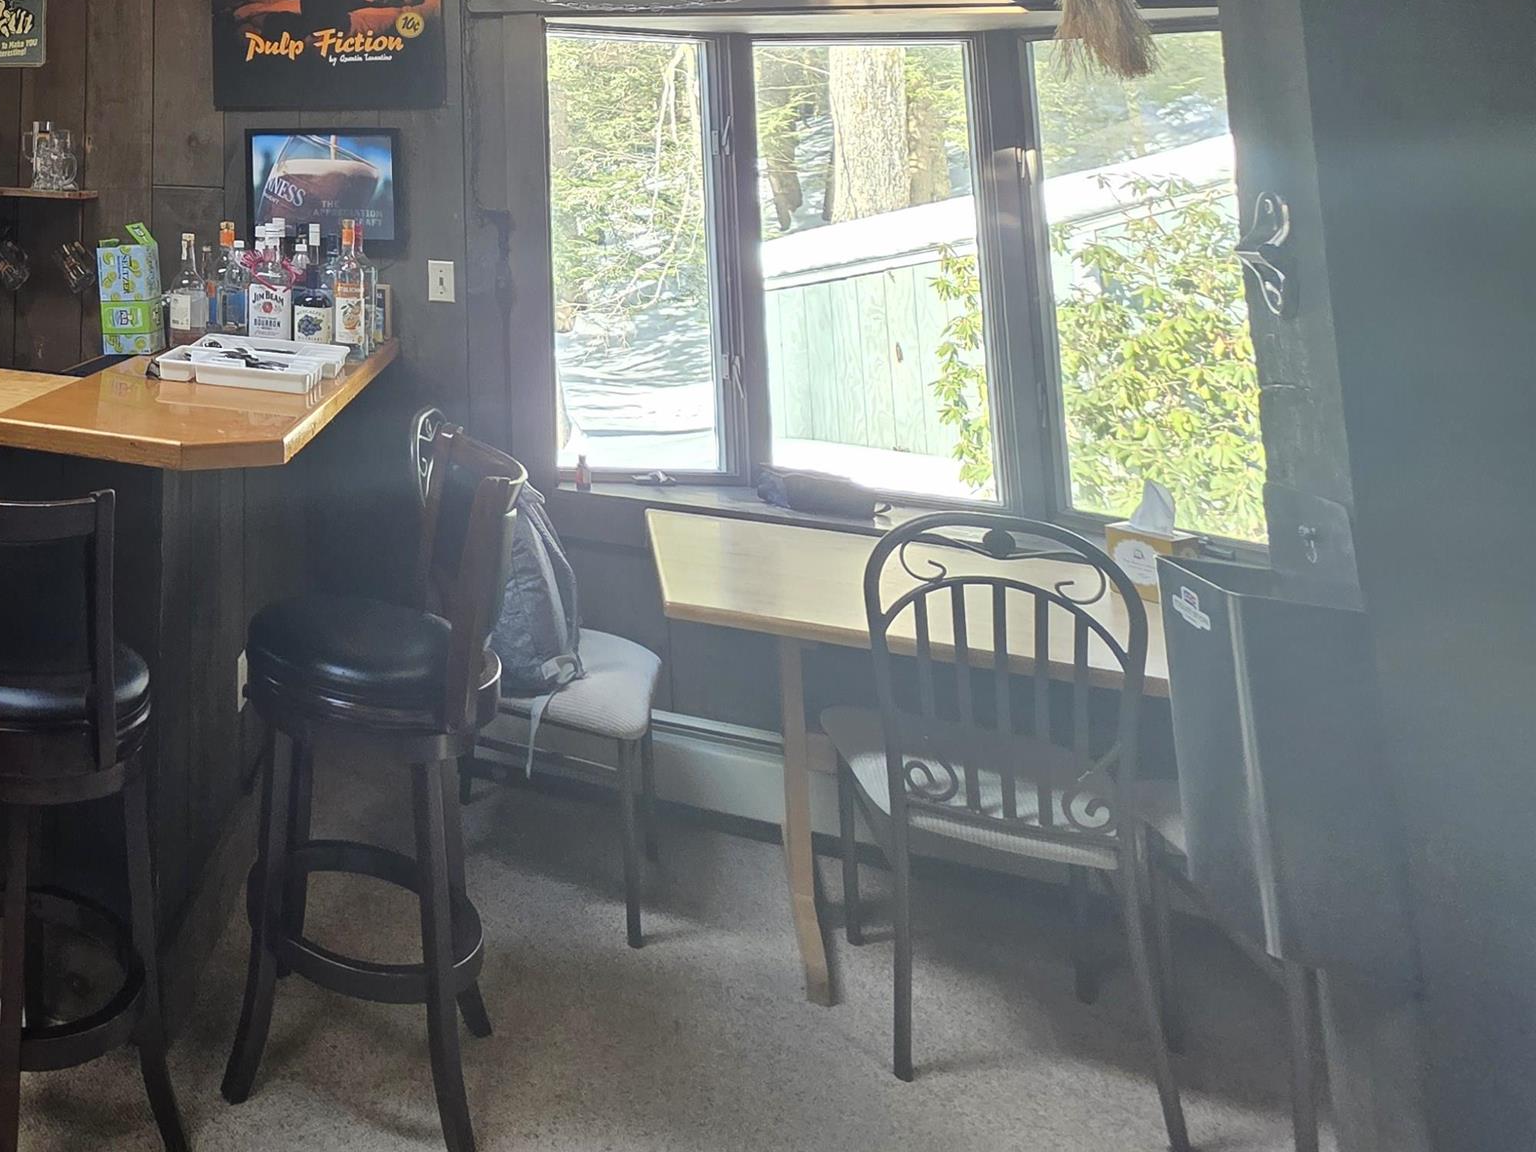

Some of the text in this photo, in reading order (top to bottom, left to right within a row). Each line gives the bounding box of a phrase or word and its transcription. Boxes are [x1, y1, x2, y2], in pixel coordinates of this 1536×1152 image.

[26, 38, 39, 47] YOU
[245, 27, 404, 62] Pulp Fiction
[328, 54, 337, 67] by
[119, 255, 131, 295] SELTZER
[252, 290, 284, 307] JIM BEAM
[254, 318, 281, 328] BOURBON
